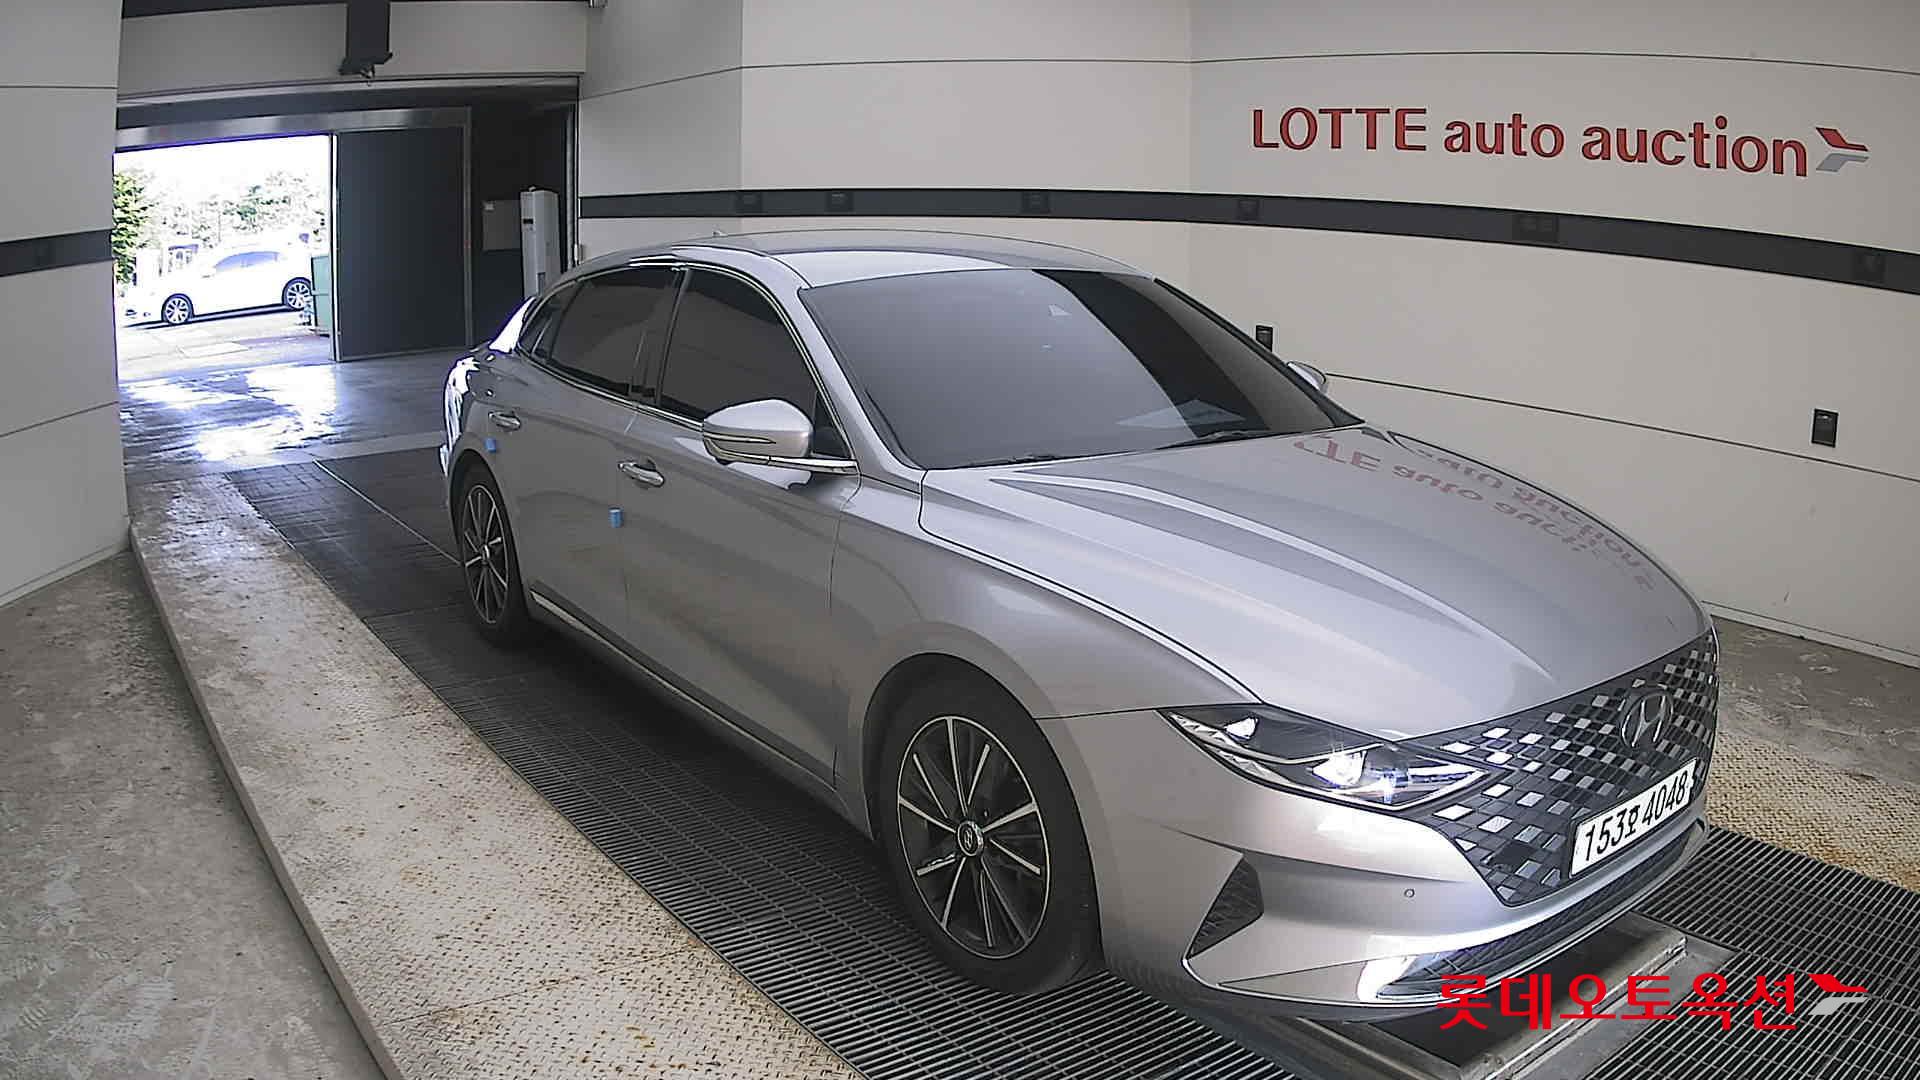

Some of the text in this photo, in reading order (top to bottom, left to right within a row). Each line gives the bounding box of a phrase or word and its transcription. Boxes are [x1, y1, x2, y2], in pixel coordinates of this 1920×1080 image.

[1252, 107, 1808, 177] LOTTE auto auction
[1640, 770, 1690, 826] 4048
